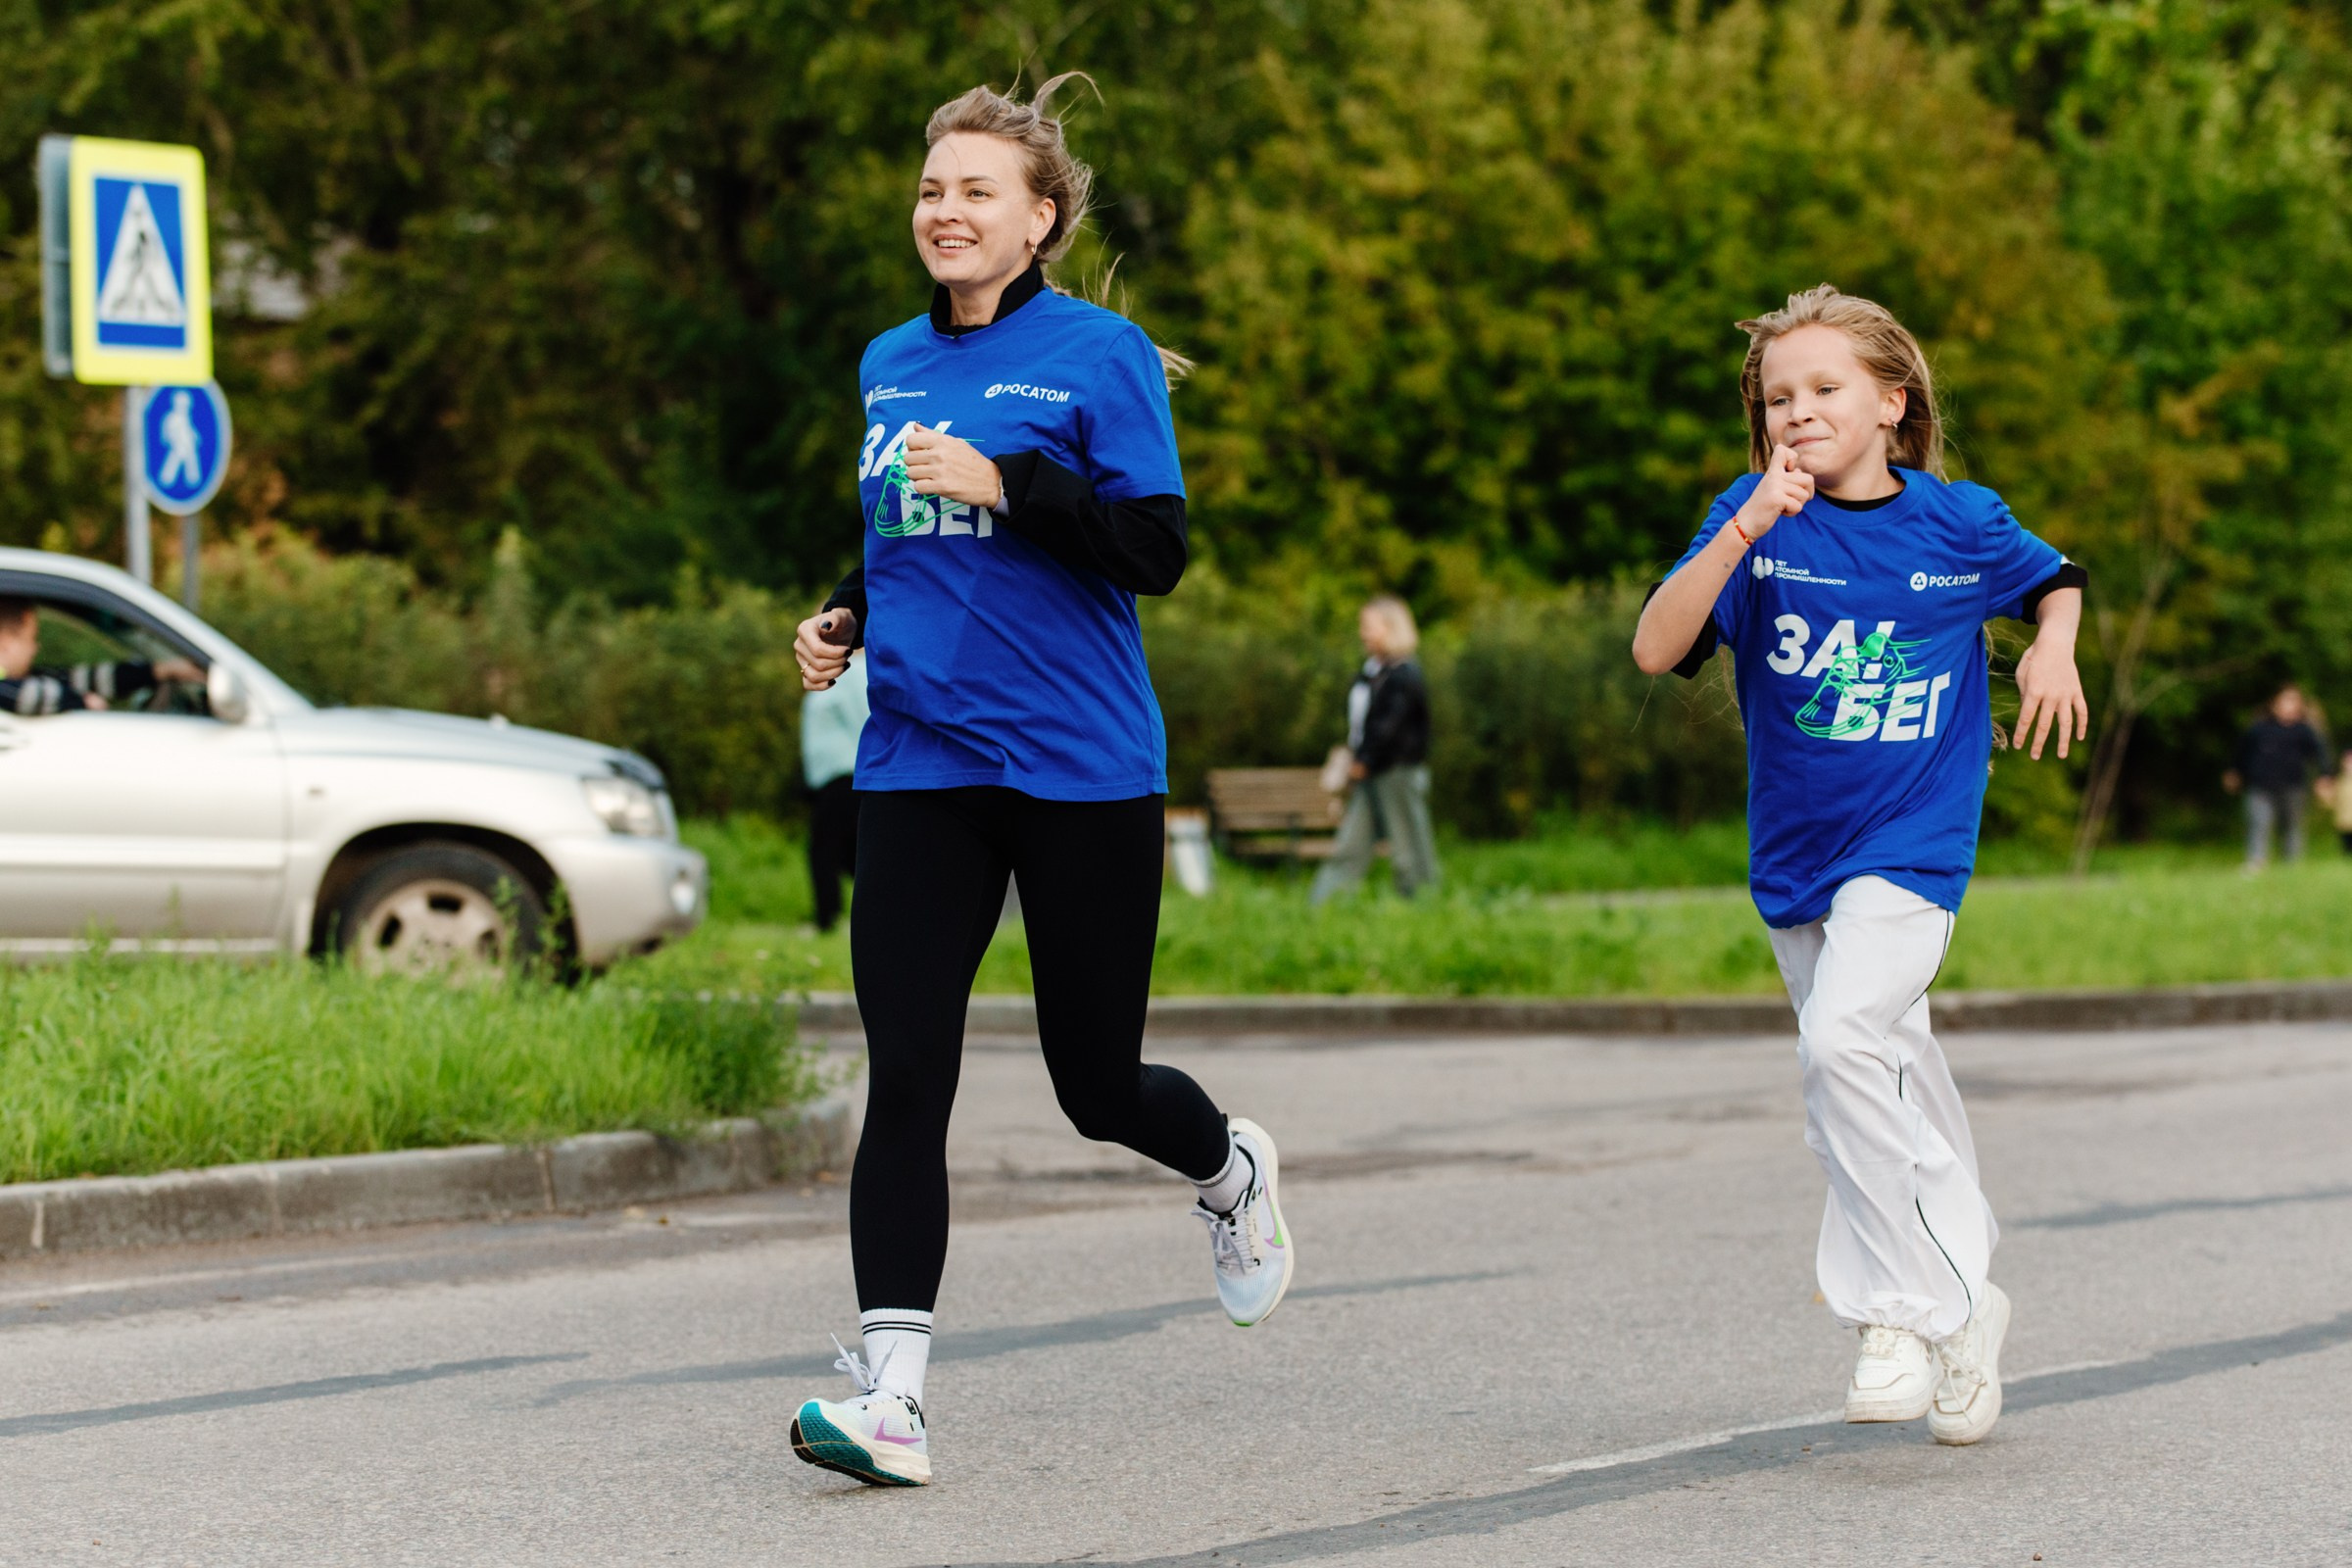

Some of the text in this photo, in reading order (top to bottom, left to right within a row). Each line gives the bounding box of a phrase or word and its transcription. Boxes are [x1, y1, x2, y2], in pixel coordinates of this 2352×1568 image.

[1002, 383, 1070, 403] РОСАТОМ
[858, 420, 953, 481] ЗА
[1775, 572, 1847, 586] ПРОМЫШЛЕННОСТИ
[1929, 572, 1981, 587] РОСАТОМ
[1829, 671, 1951, 742] БЕГ
